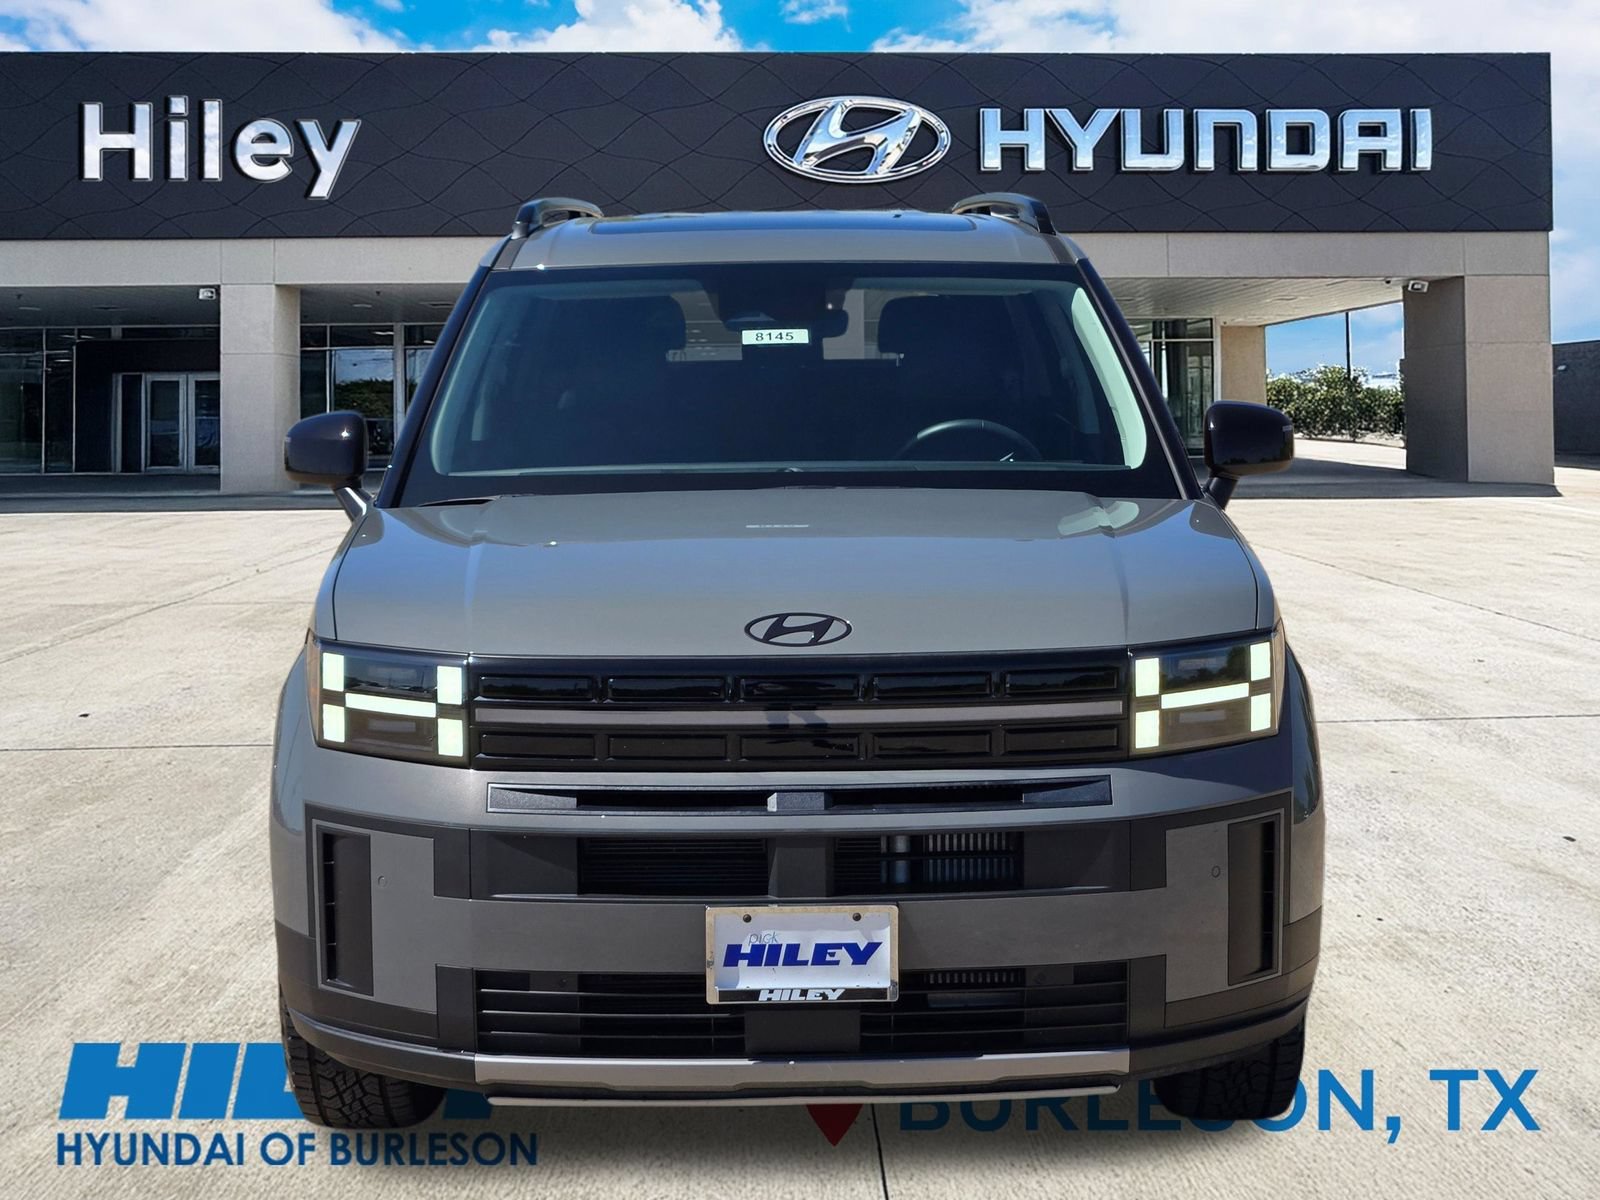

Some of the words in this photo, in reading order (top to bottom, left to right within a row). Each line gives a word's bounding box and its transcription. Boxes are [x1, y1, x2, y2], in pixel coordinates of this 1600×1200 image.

[80, 95, 361, 200] Hiley
[979, 107, 1433, 172] HYUNDAI
[755, 331, 795, 342] 8145
[723, 942, 883, 967] HILEY
[758, 988, 845, 1001] HILEY
